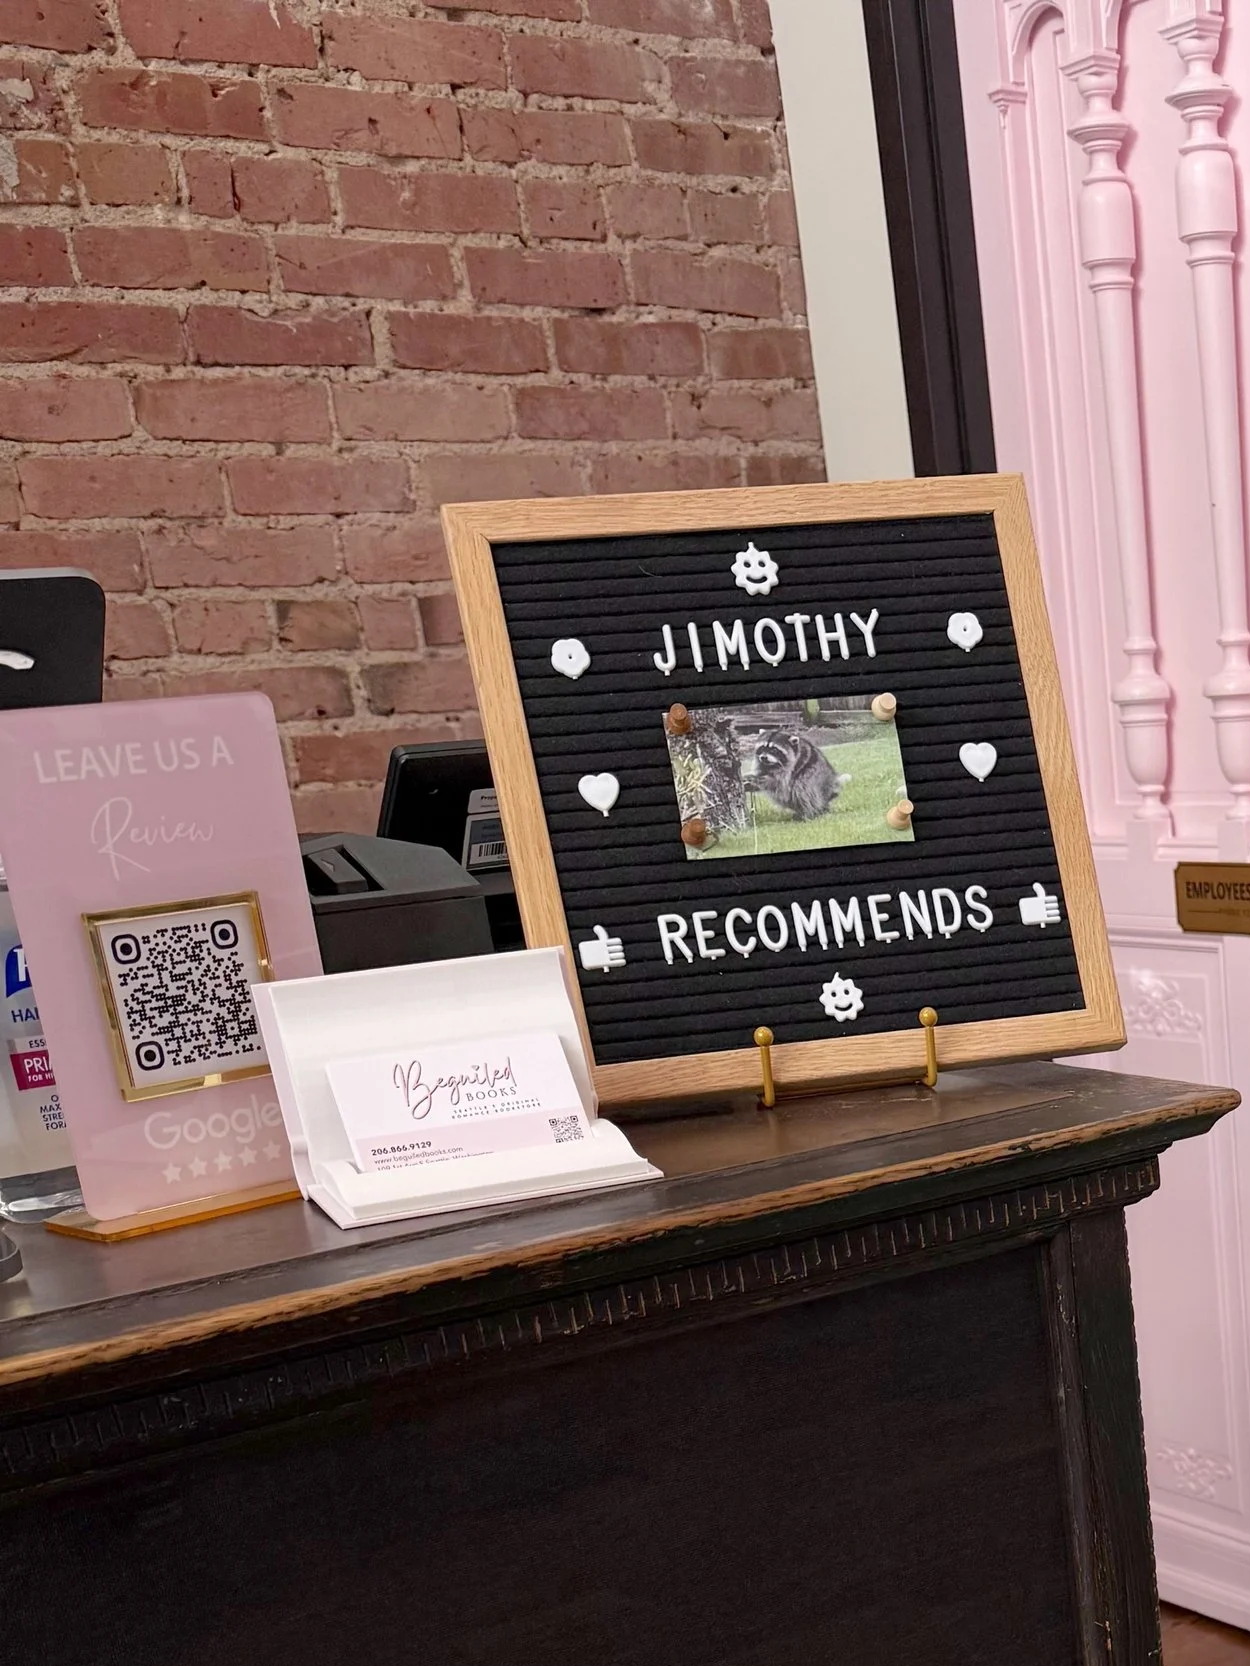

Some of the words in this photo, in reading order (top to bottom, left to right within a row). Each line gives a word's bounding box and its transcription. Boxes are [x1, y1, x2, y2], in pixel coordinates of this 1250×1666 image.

[653, 608, 879, 675] JIMOTHY
[34, 742, 147, 784] LEAVE
[153, 738, 200, 772] US
[211, 735, 234, 766] A
[91, 796, 213, 881] Review
[657, 884, 994, 964] RECOMMENDS
[11, 1007, 40, 1023] HA
[24, 1056, 52, 1074] PRI
[393, 1056, 518, 1120] Beguiled
[466, 1086, 517, 1102] BOOKS
[42, 1112, 64, 1122] STRE
[46, 1121, 67, 1131] FOR
[144, 1094, 283, 1149] Google
[371, 1140, 432, 1156] 206.866.9129
